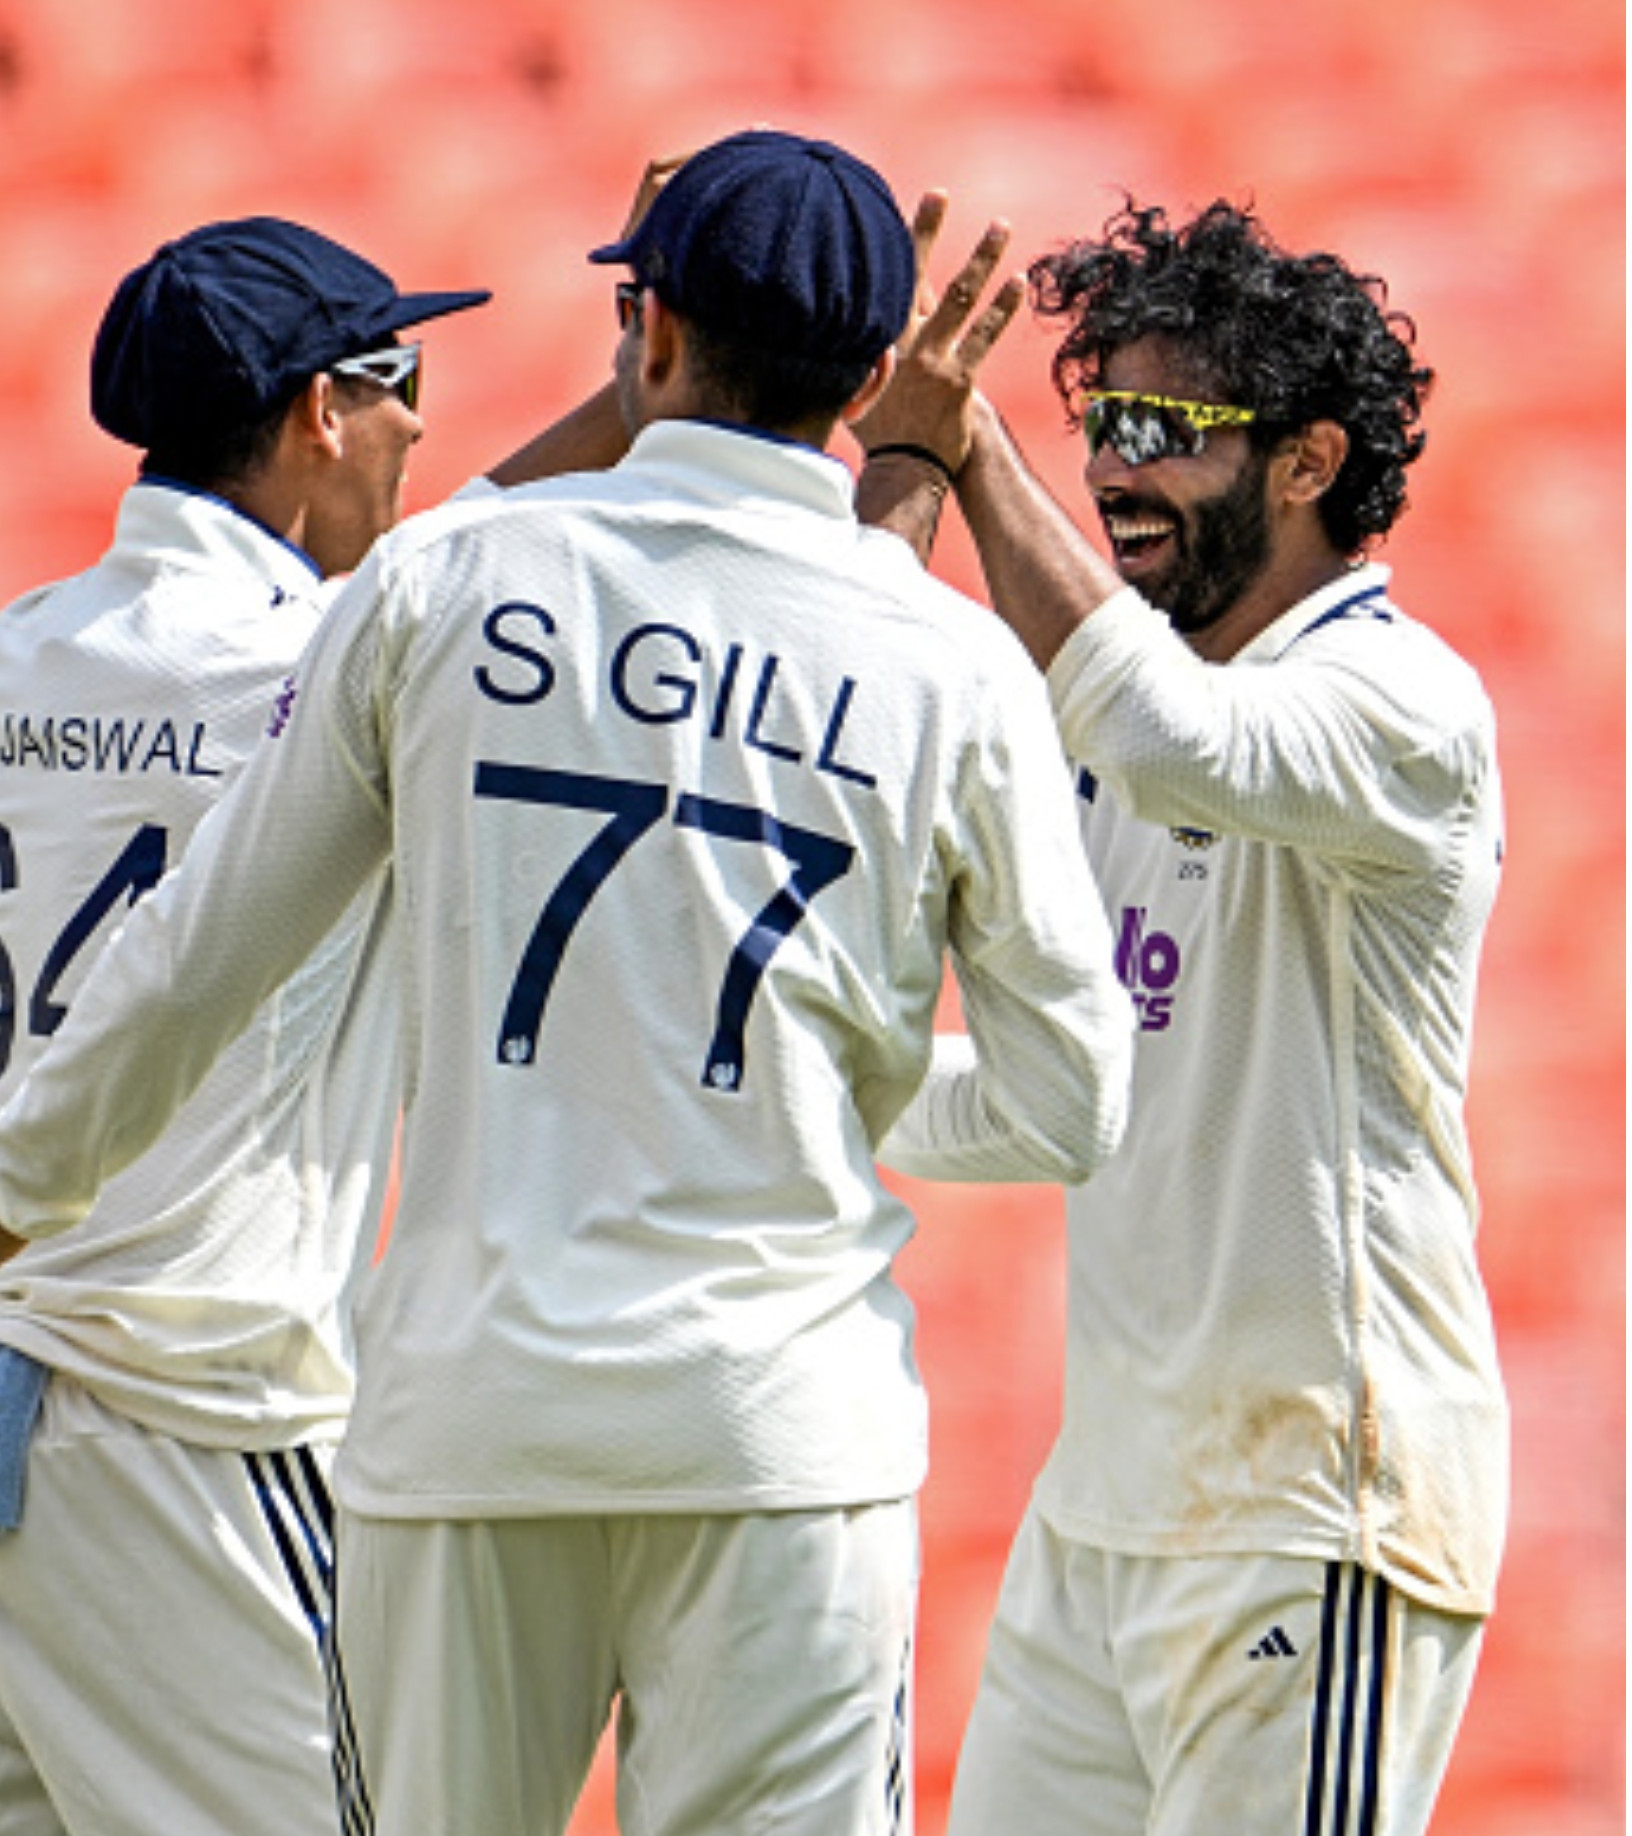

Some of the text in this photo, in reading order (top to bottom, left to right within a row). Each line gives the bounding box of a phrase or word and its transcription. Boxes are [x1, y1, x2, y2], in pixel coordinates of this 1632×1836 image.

[0, 712, 222, 777] JAISWAL
[474, 601, 877, 789] S GILL
[474, 760, 857, 1091] 77
